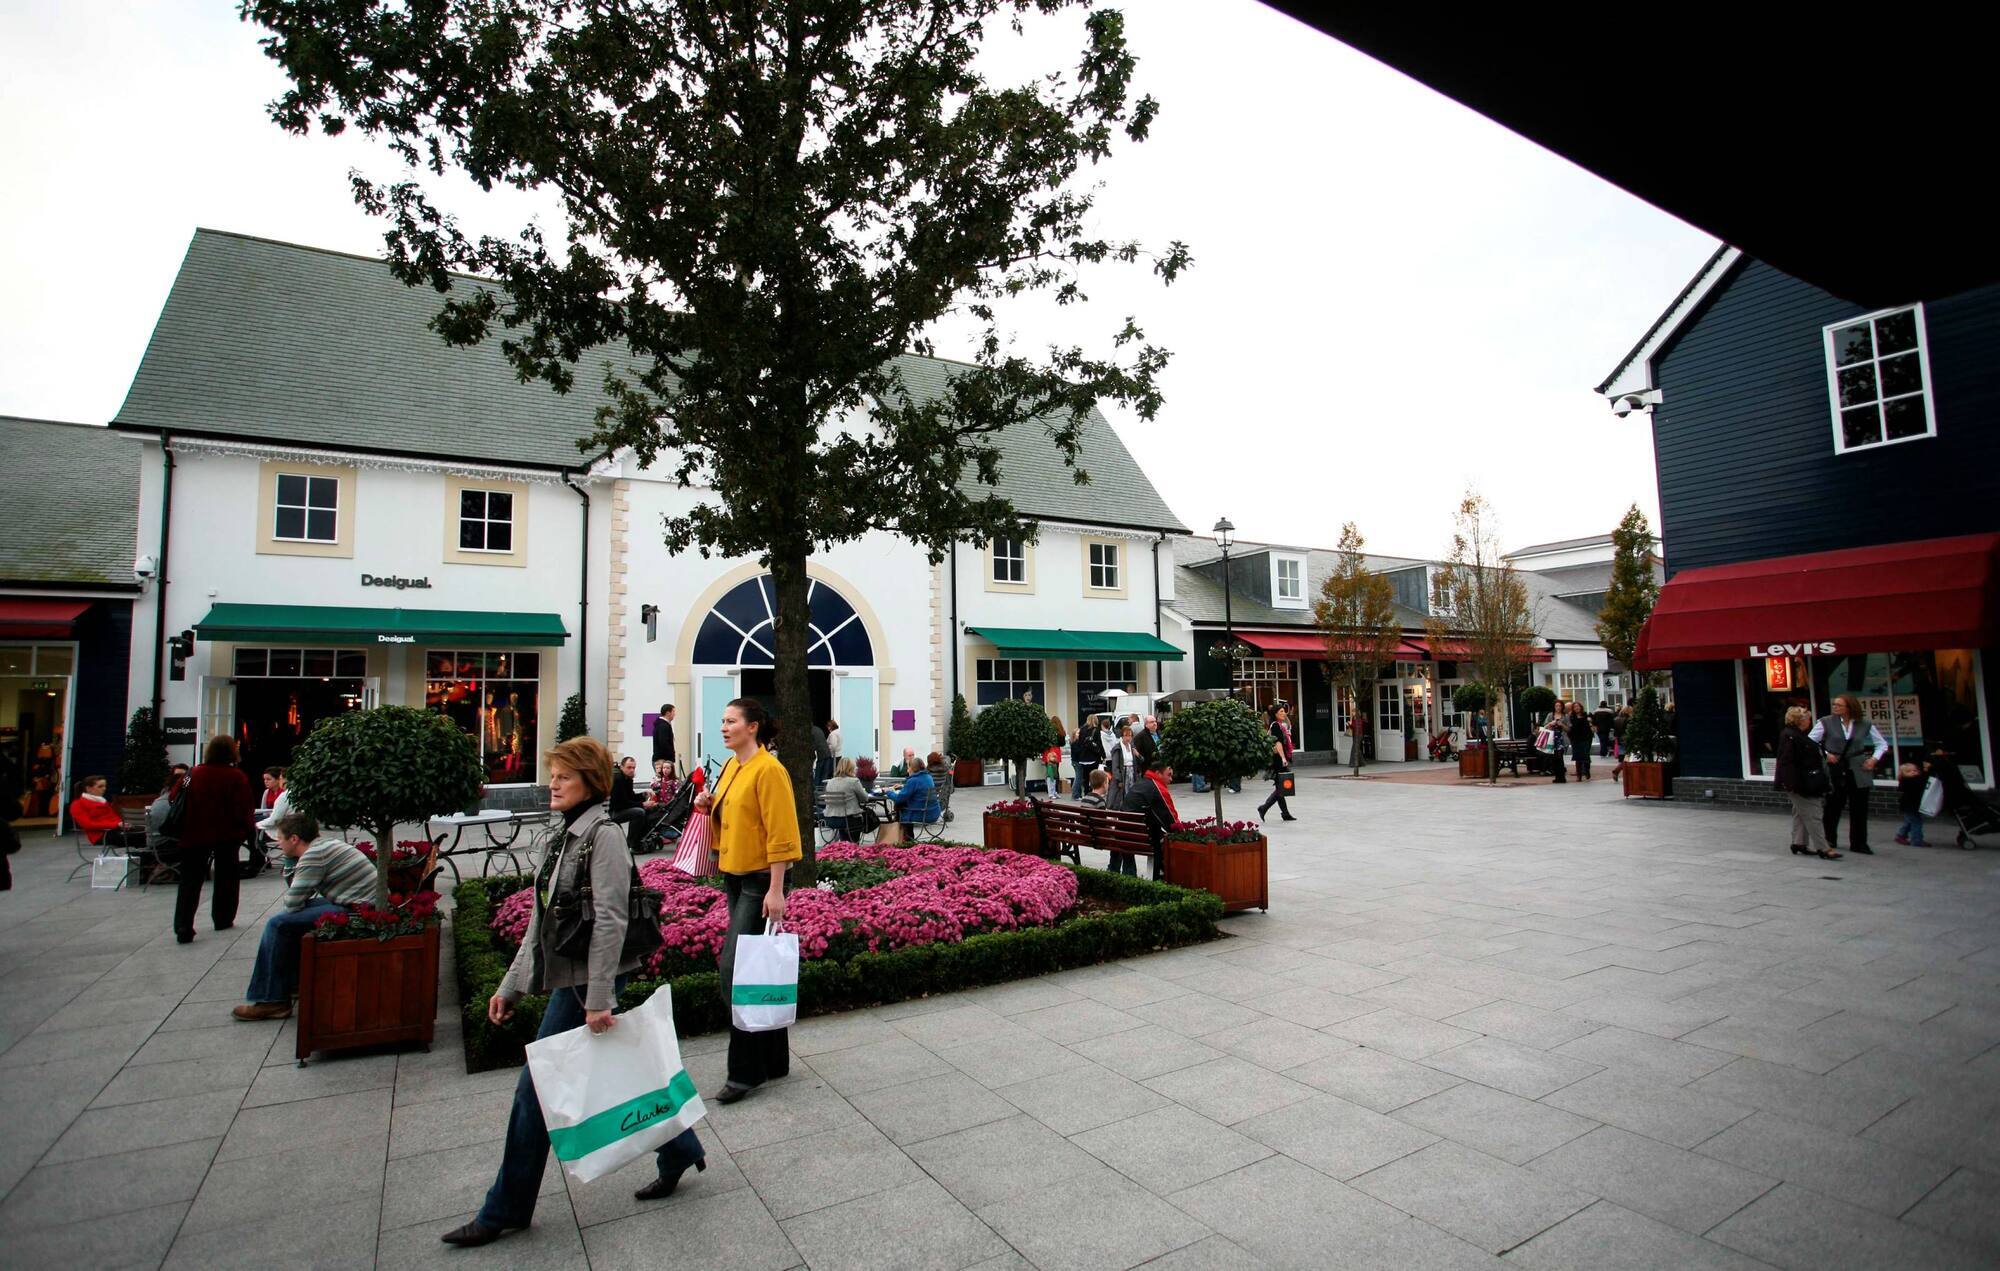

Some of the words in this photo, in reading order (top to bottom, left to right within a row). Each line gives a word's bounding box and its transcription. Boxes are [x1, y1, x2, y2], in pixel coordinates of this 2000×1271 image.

[361, 574, 432, 590] Desigual.
[378, 635, 416, 643] Desigual.
[620, 1103, 671, 1132] Clarks
